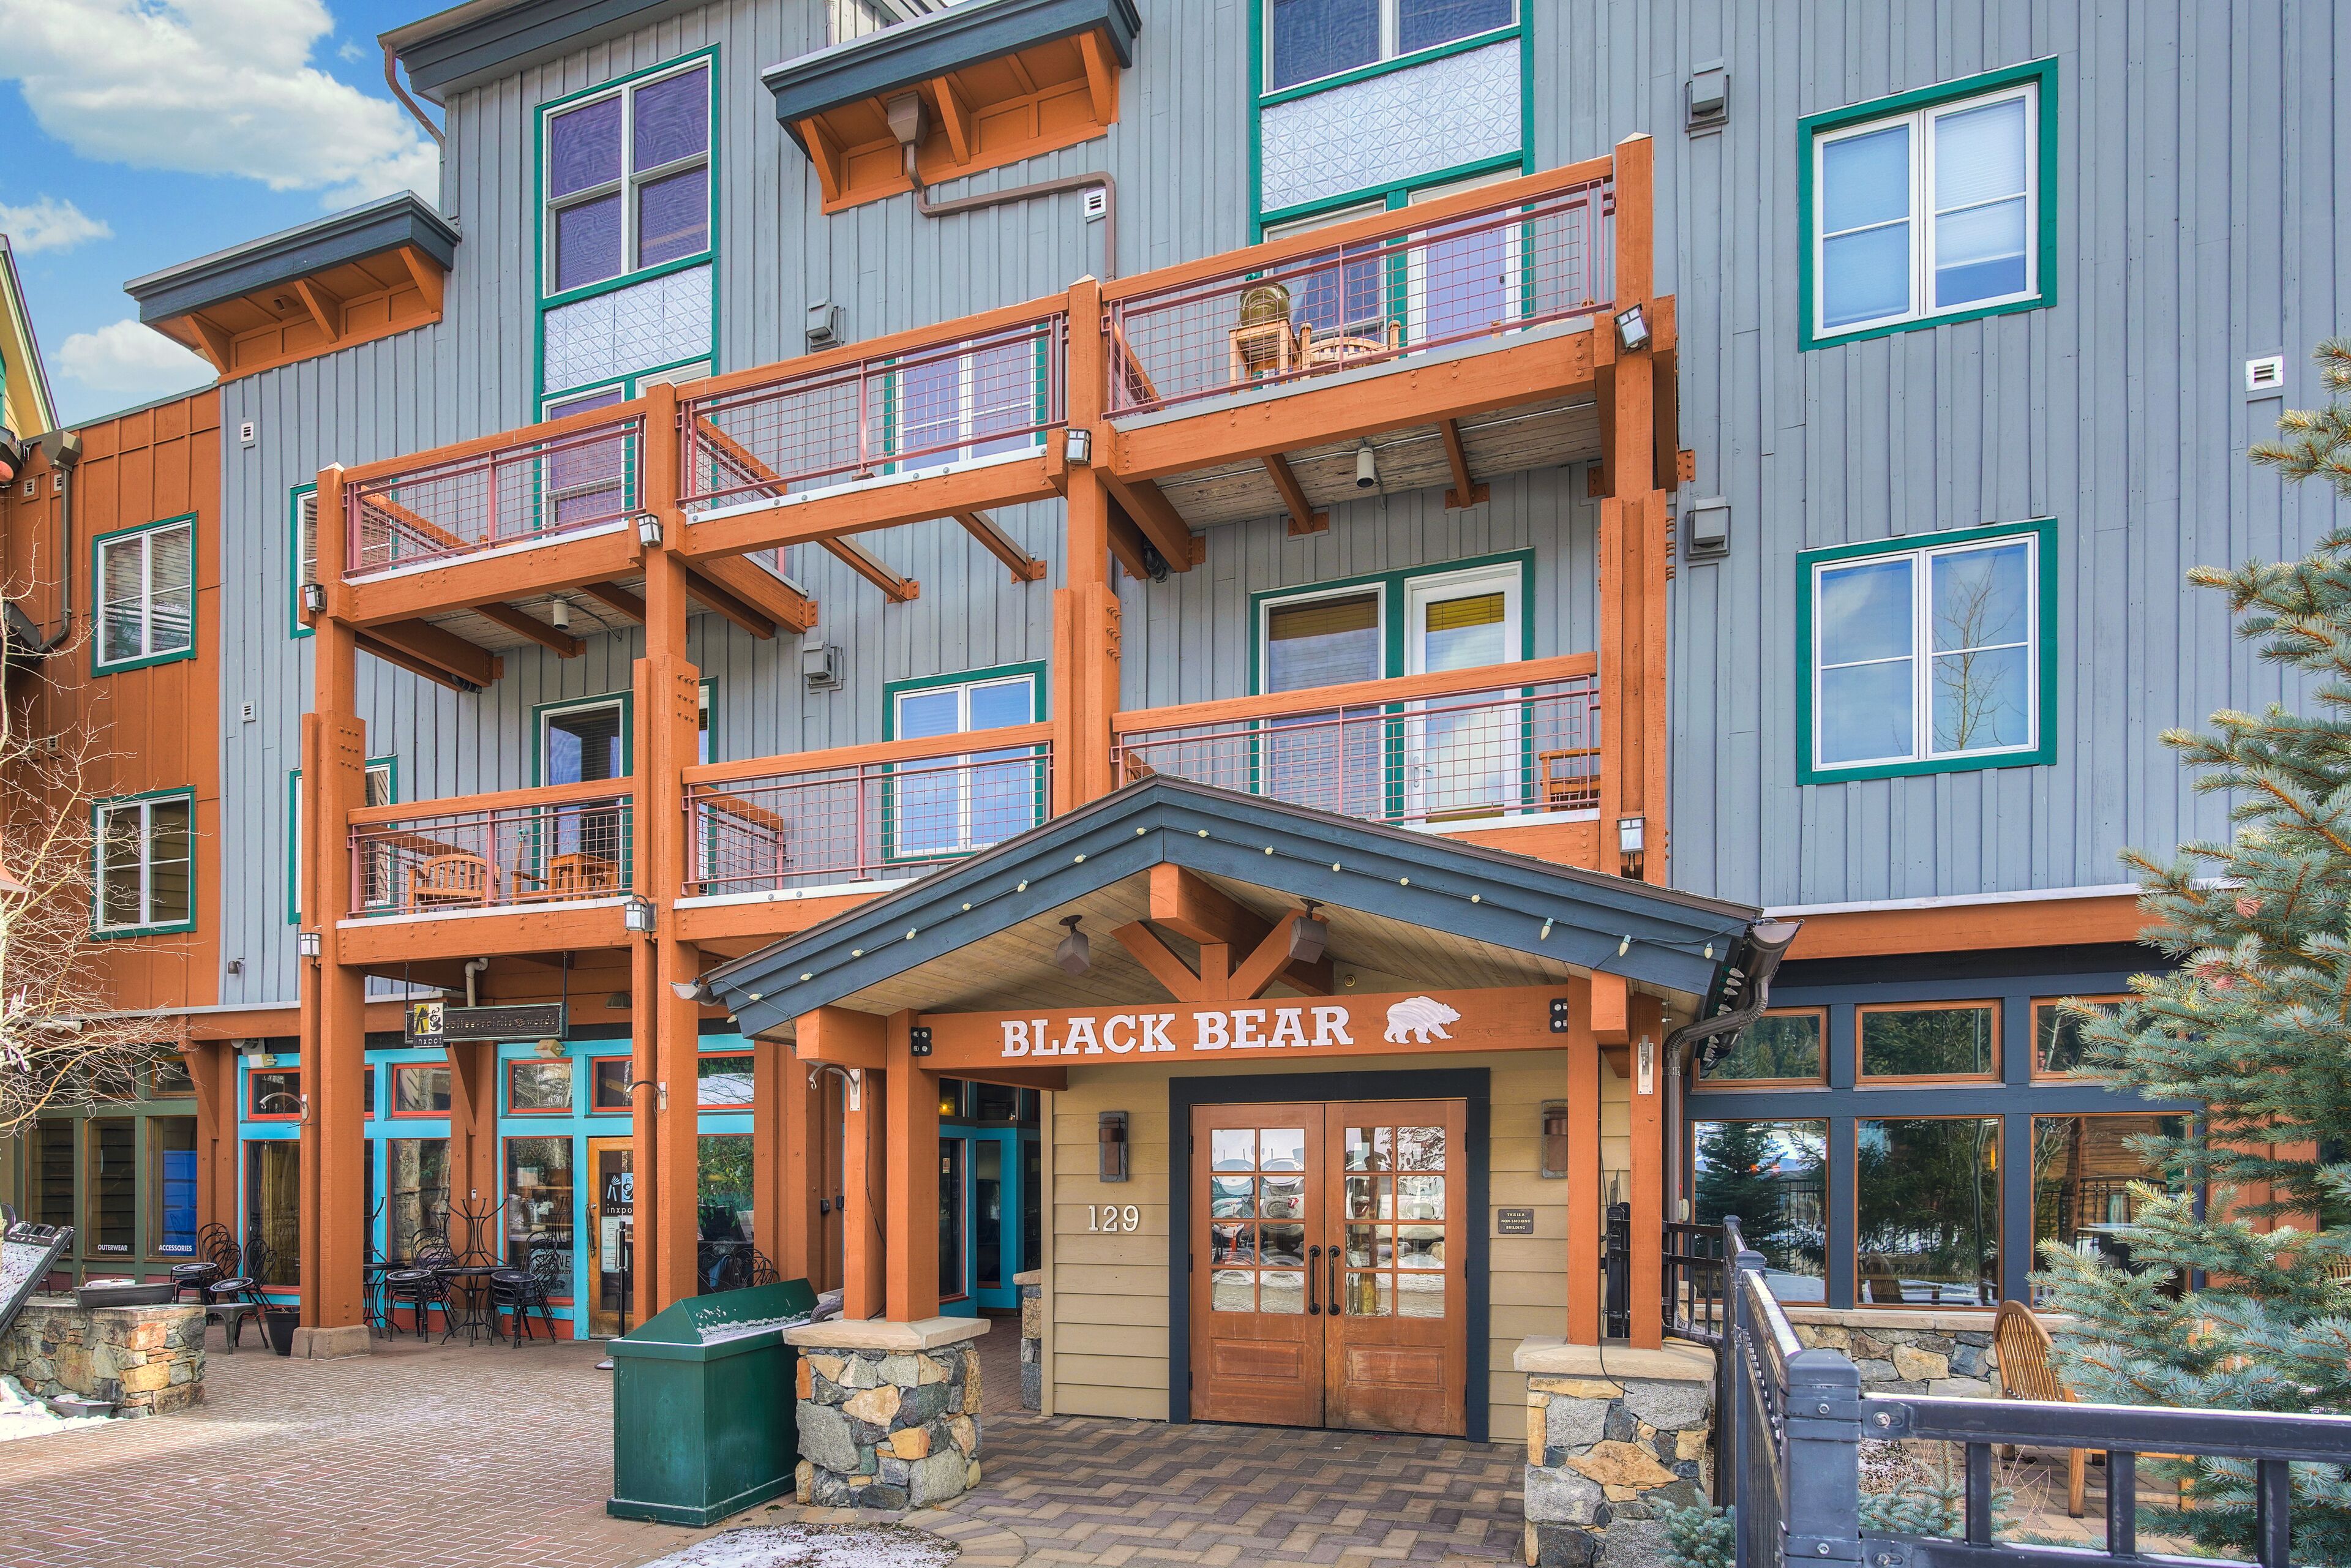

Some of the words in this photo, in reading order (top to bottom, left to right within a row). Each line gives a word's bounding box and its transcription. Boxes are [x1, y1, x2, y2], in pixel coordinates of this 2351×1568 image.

[527, 1015, 557, 1026] words
[1000, 1013, 1176, 1057] BLACK
[1193, 1006, 1354, 1051] BEAR
[607, 1204, 633, 1215] inxpo
[1088, 1205, 1139, 1232] 129
